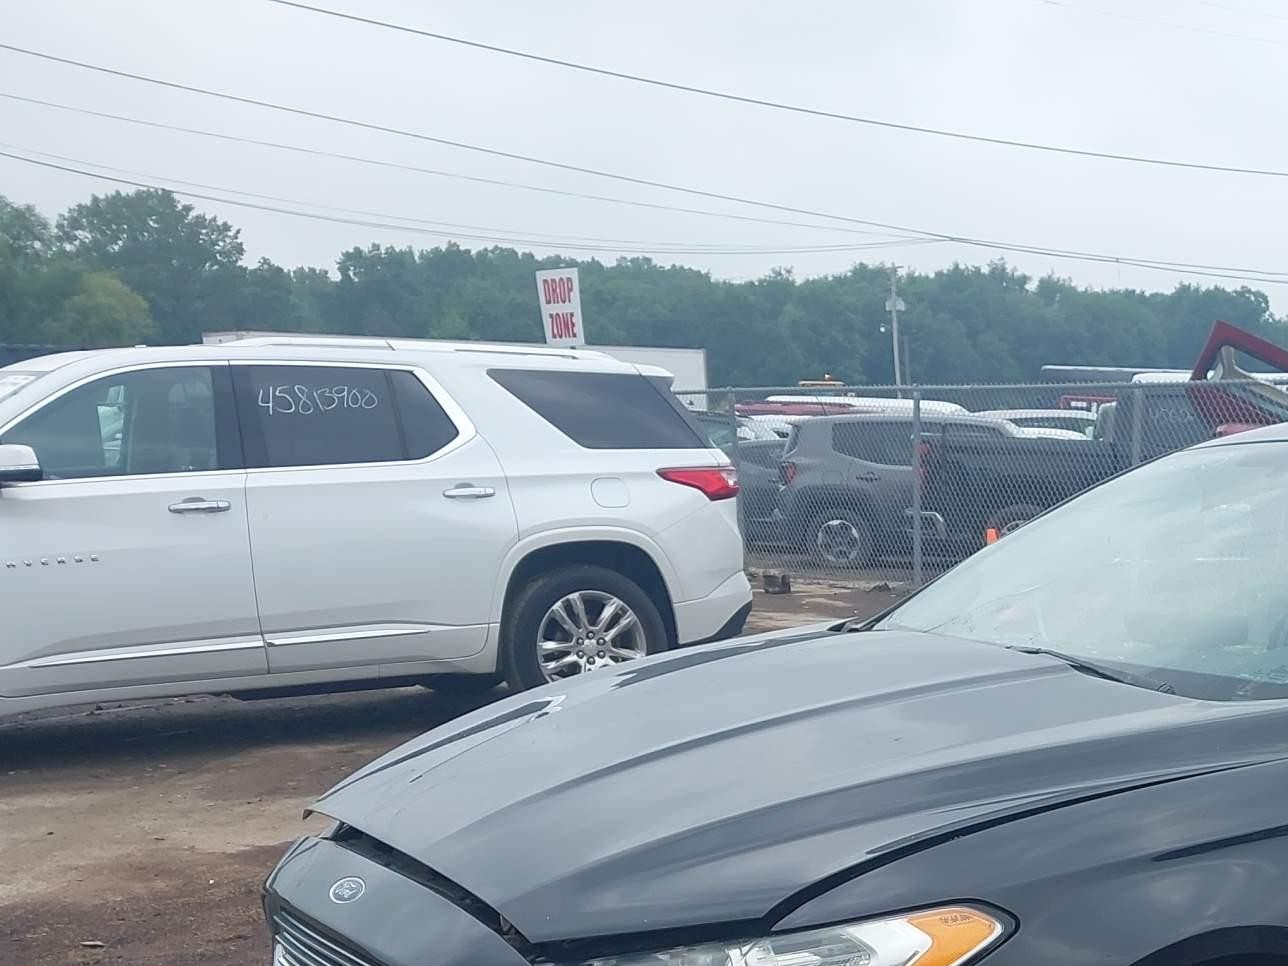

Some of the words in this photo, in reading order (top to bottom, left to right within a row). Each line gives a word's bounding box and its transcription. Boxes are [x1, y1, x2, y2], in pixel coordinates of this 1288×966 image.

[542, 277, 573, 304] DROP
[549, 312, 576, 339] ZONE
[258, 384, 378, 415] 45813900
